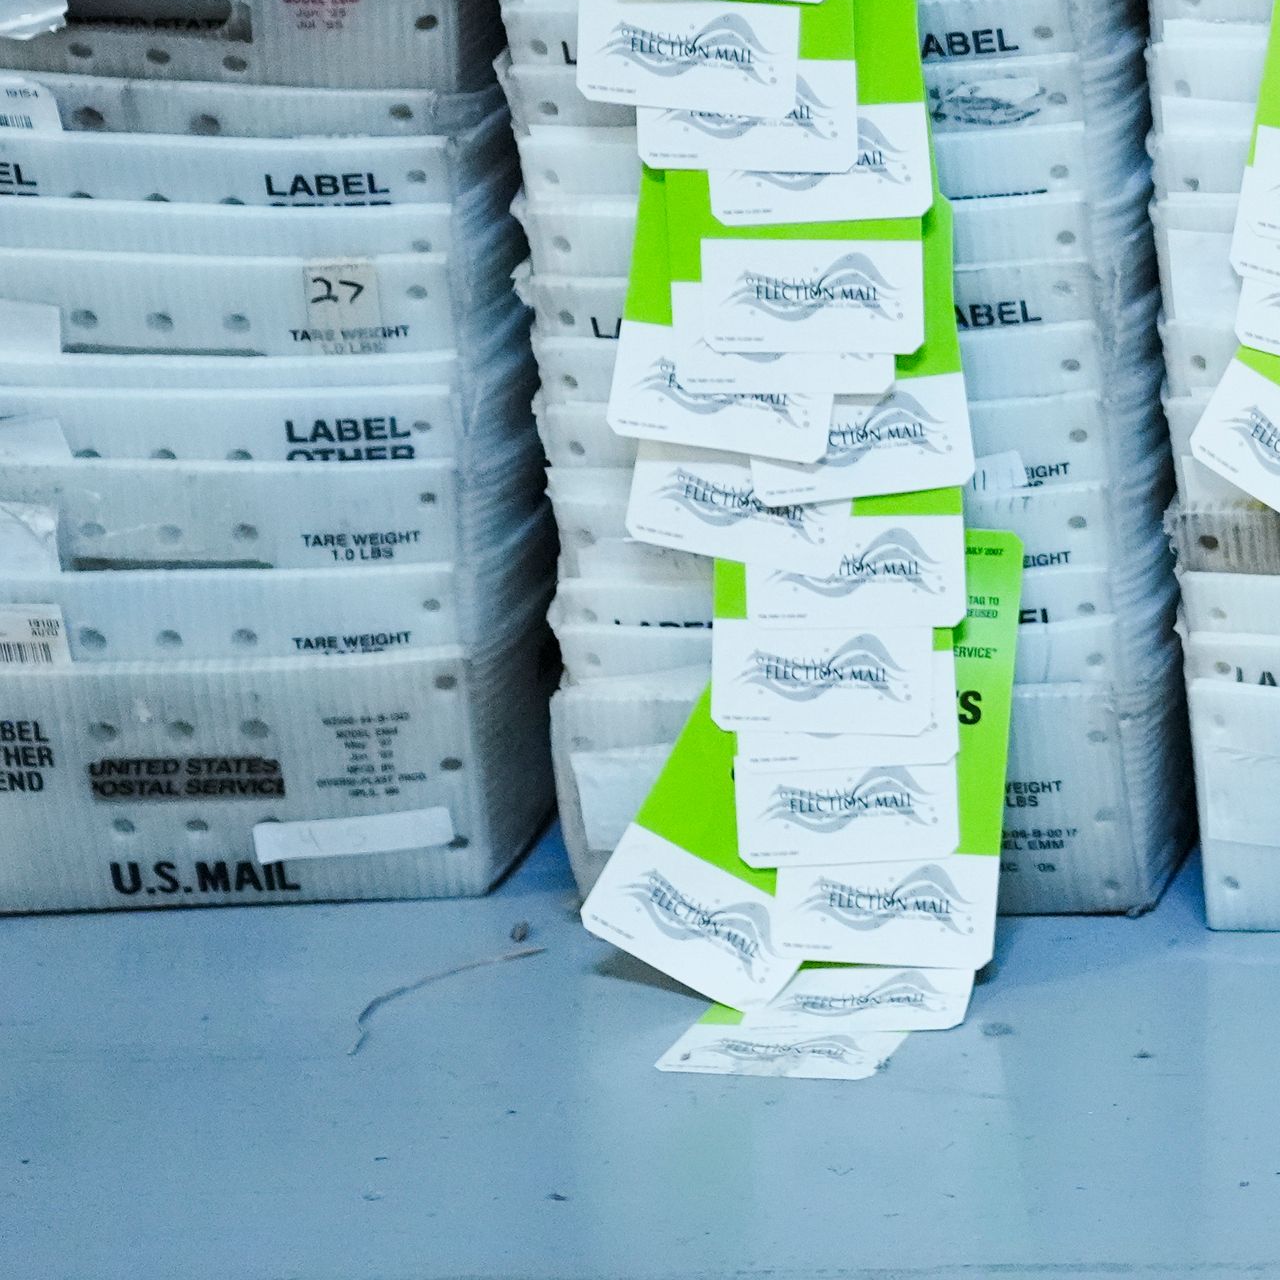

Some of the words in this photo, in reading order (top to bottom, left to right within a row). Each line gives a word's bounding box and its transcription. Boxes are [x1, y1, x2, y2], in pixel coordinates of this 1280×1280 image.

[286, 417, 411, 443] LABEL
[302, 534, 347, 547] TARE
[351, 530, 421, 547] WEIGHT
[332, 548, 355, 561] 1.0
[360, 546, 394, 560] LBS
[110, 861, 193, 896] U.S.
[195, 861, 301, 894] MAIL
